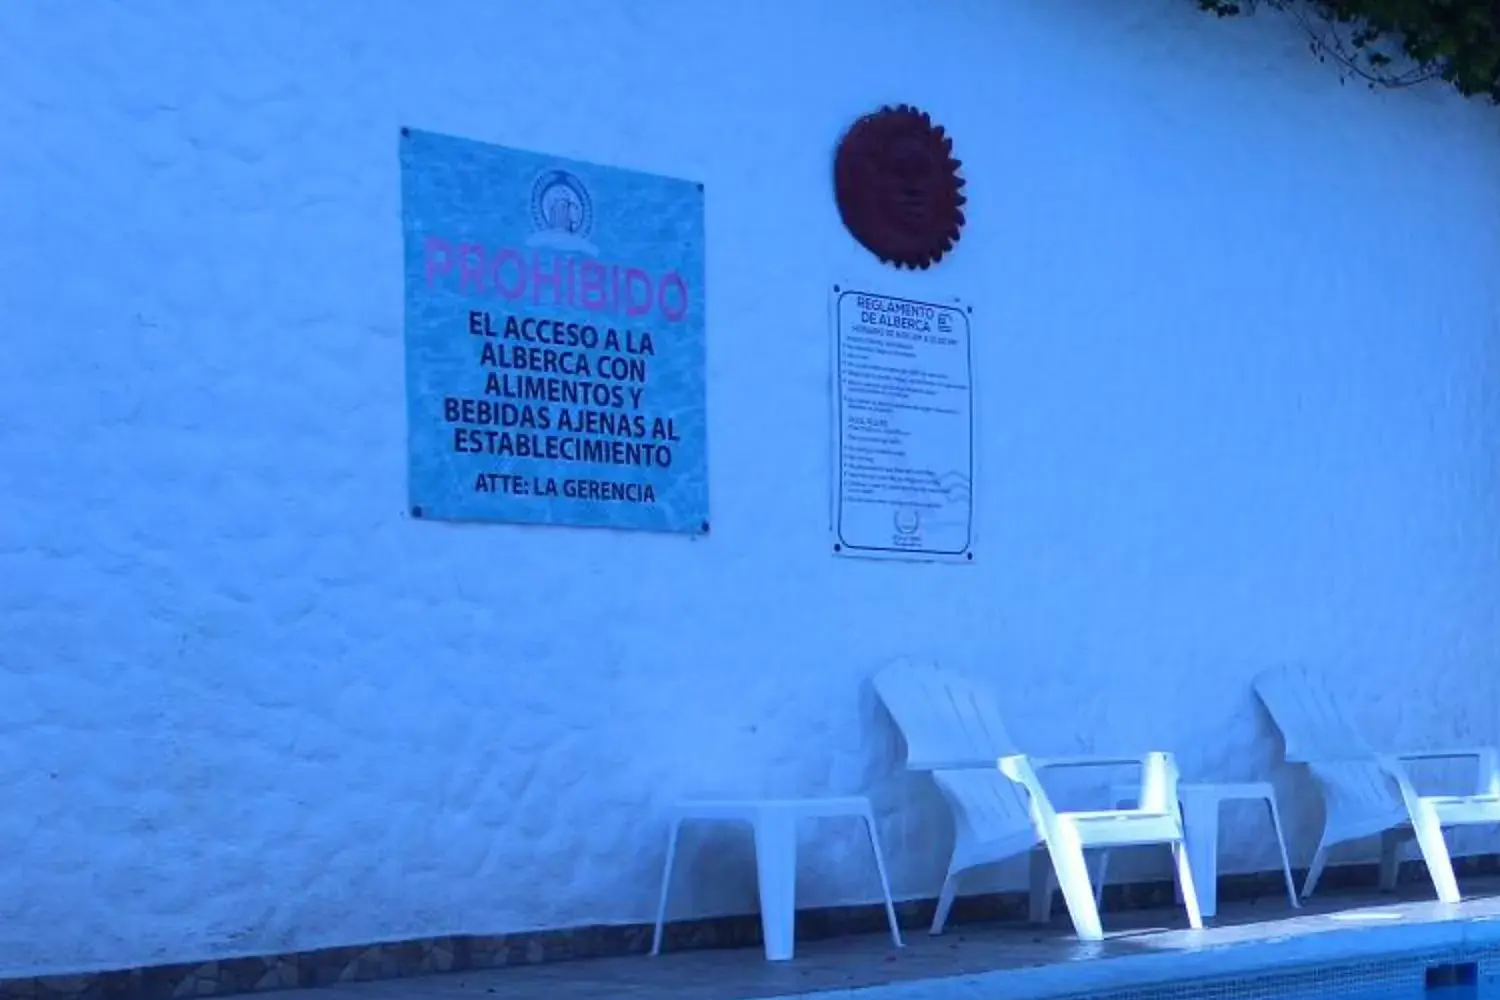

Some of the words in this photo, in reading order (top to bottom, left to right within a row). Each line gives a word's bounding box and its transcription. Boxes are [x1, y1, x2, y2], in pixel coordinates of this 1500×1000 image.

[424, 235, 688, 323] PROHIBIDO
[857, 296, 935, 319] REGLAMENTO
[861, 311, 877, 325] DE
[880, 314, 931, 332] ALBERCA
[469, 310, 498, 336] EL
[504, 315, 598, 348] ACCESO
[604, 328, 620, 352] A
[626, 330, 654, 356] LA
[480, 342, 591, 376] ALBERCA
[598, 355, 645, 382] CON
[484, 372, 624, 408] ALIMENTOS
[629, 386, 644, 410] Y
[444, 397, 550, 430] BEBIDAS
[557, 408, 645, 438] AJENAS
[652, 417, 681, 441] AL
[454, 428, 672, 468] ESTABLECIMIENTO
[474, 472, 529, 496] ATTE:
[534, 477, 558, 496] LA
[563, 479, 656, 503] GERENCIA
